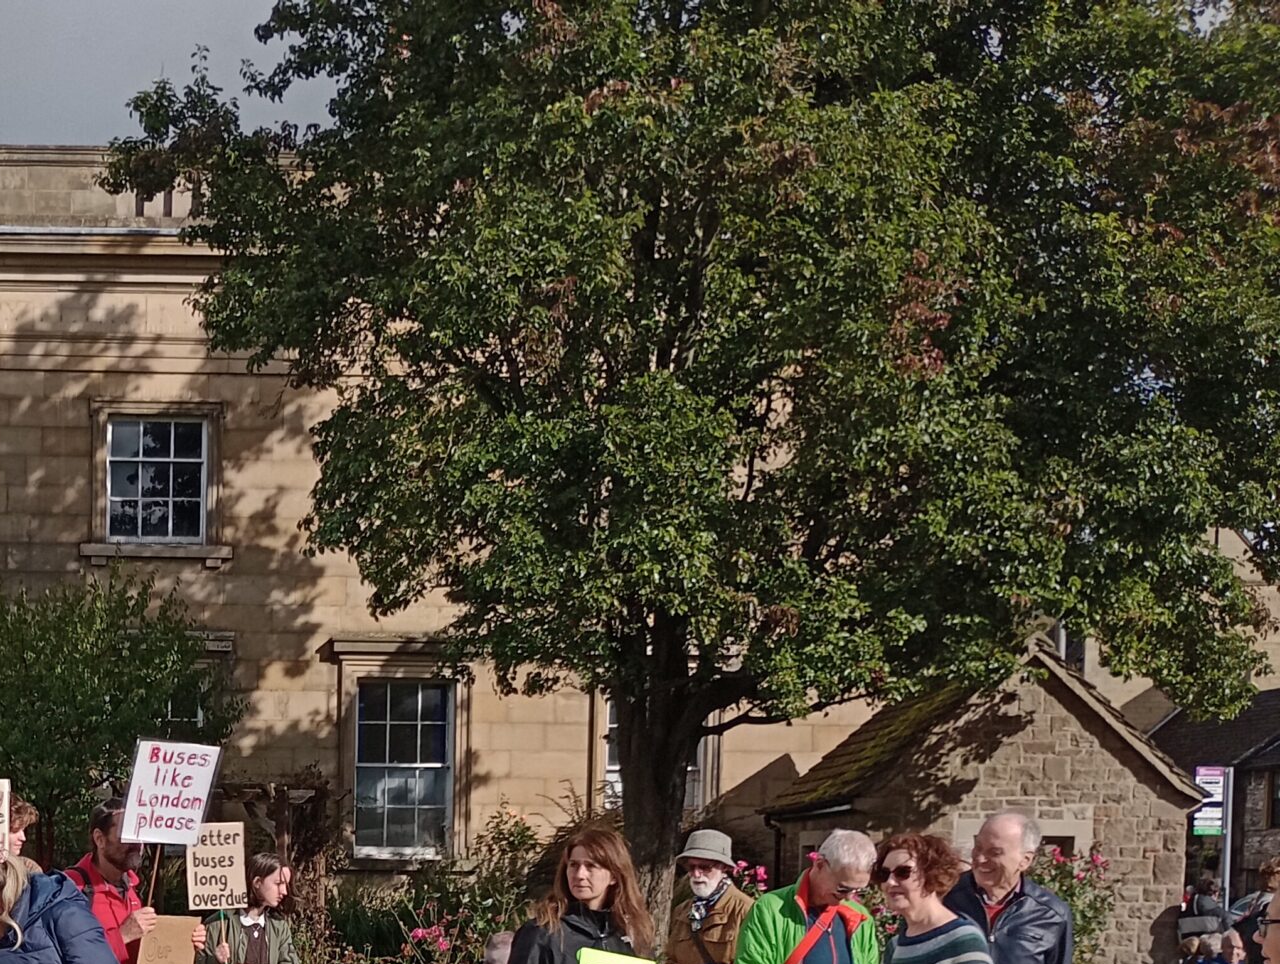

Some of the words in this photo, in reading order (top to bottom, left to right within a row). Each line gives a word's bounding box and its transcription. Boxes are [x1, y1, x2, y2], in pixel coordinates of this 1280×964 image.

[149, 743, 211, 768] Buses
[154, 765, 194, 788] like
[136, 785, 205, 812] London
[134, 810, 196, 840] please
[193, 851, 234, 869] buses
[194, 871, 228, 892] long
[193, 889, 248, 907] overdue
